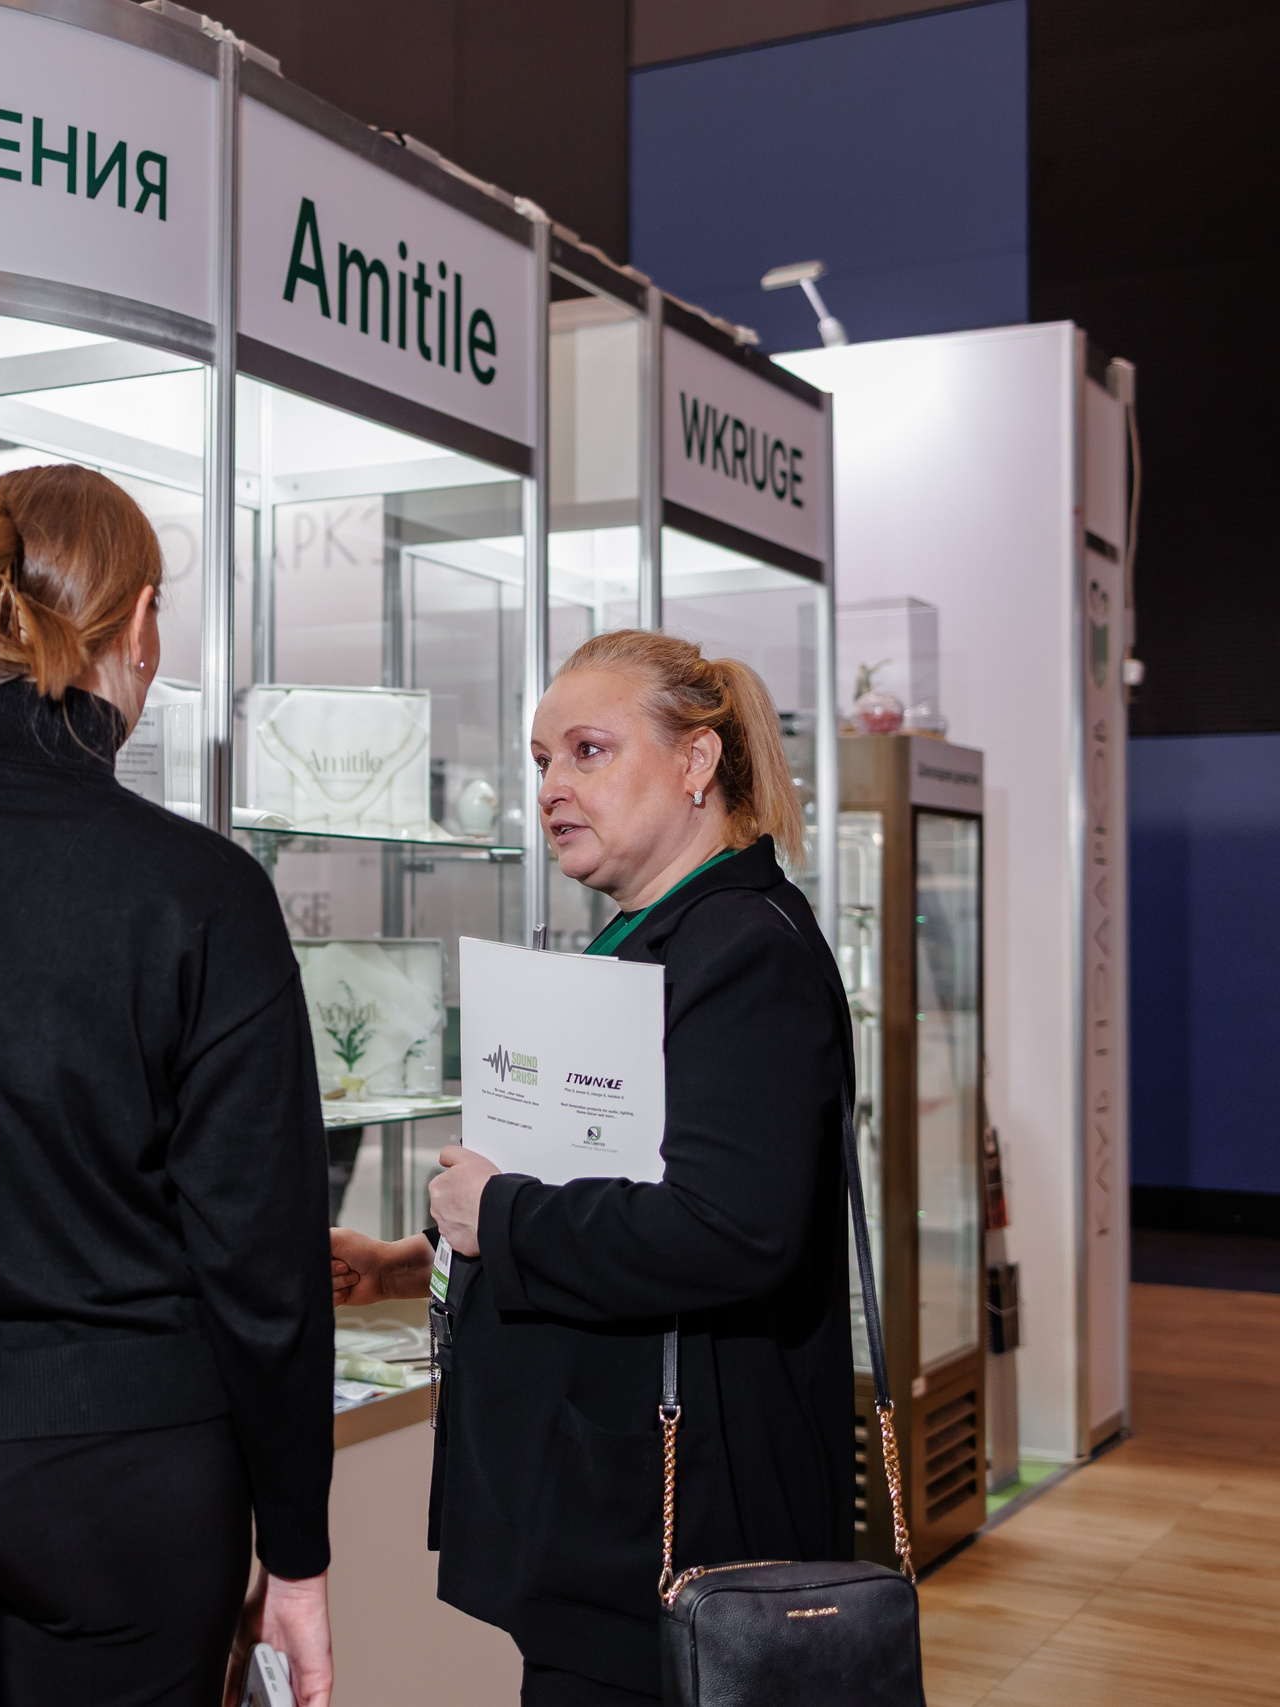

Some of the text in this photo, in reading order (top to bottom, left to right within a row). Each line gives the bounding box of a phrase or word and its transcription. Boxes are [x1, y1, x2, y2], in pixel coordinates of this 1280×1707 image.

[282, 196, 497, 386] Amitile
[679, 391, 805, 510] WKRUGE
[307, 748, 384, 774] Amitile
[511, 1052, 538, 1069] SOUND
[511, 1069, 538, 1086] CRUSH
